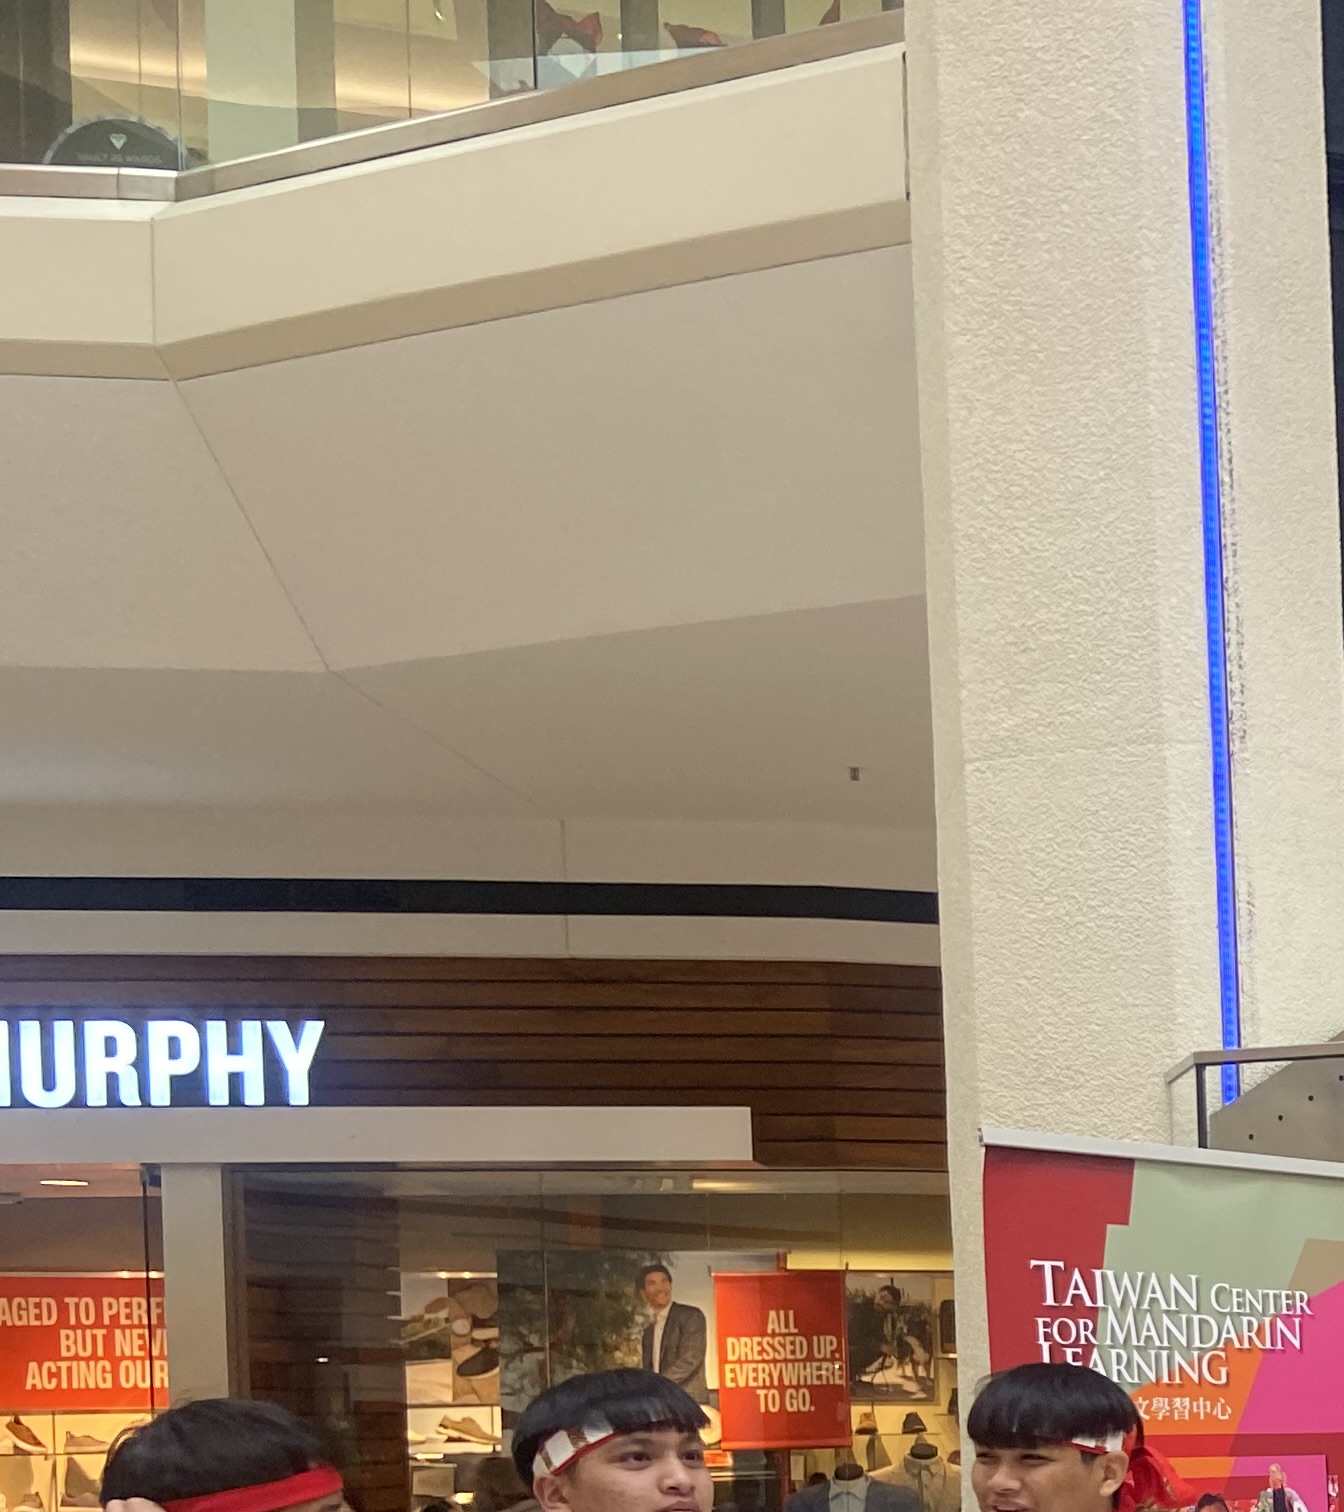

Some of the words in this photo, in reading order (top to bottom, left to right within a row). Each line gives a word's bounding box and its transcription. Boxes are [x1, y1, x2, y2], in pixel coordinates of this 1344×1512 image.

[1029, 1259, 1198, 1312] TAIWAN
[1210, 1282, 1313, 1316] CENTER
[0, 1296, 58, 1327] AGED
[64, 1297, 96, 1326] TO
[102, 1296, 163, 1326] PERF
[767, 1310, 799, 1334] ALL
[59, 1328, 107, 1358] BUT
[1035, 1316, 1099, 1346] FOR
[1103, 1305, 1303, 1351] MANDARIN
[726, 1336, 808, 1361] DRESSED
[812, 1335, 840, 1359] UP.
[25, 1360, 113, 1391] ACTING
[119, 1359, 169, 1389] OUR
[725, 1361, 844, 1388] EVERYWHERE
[756, 1389, 780, 1413] TO
[785, 1388, 815, 1412] GO.
